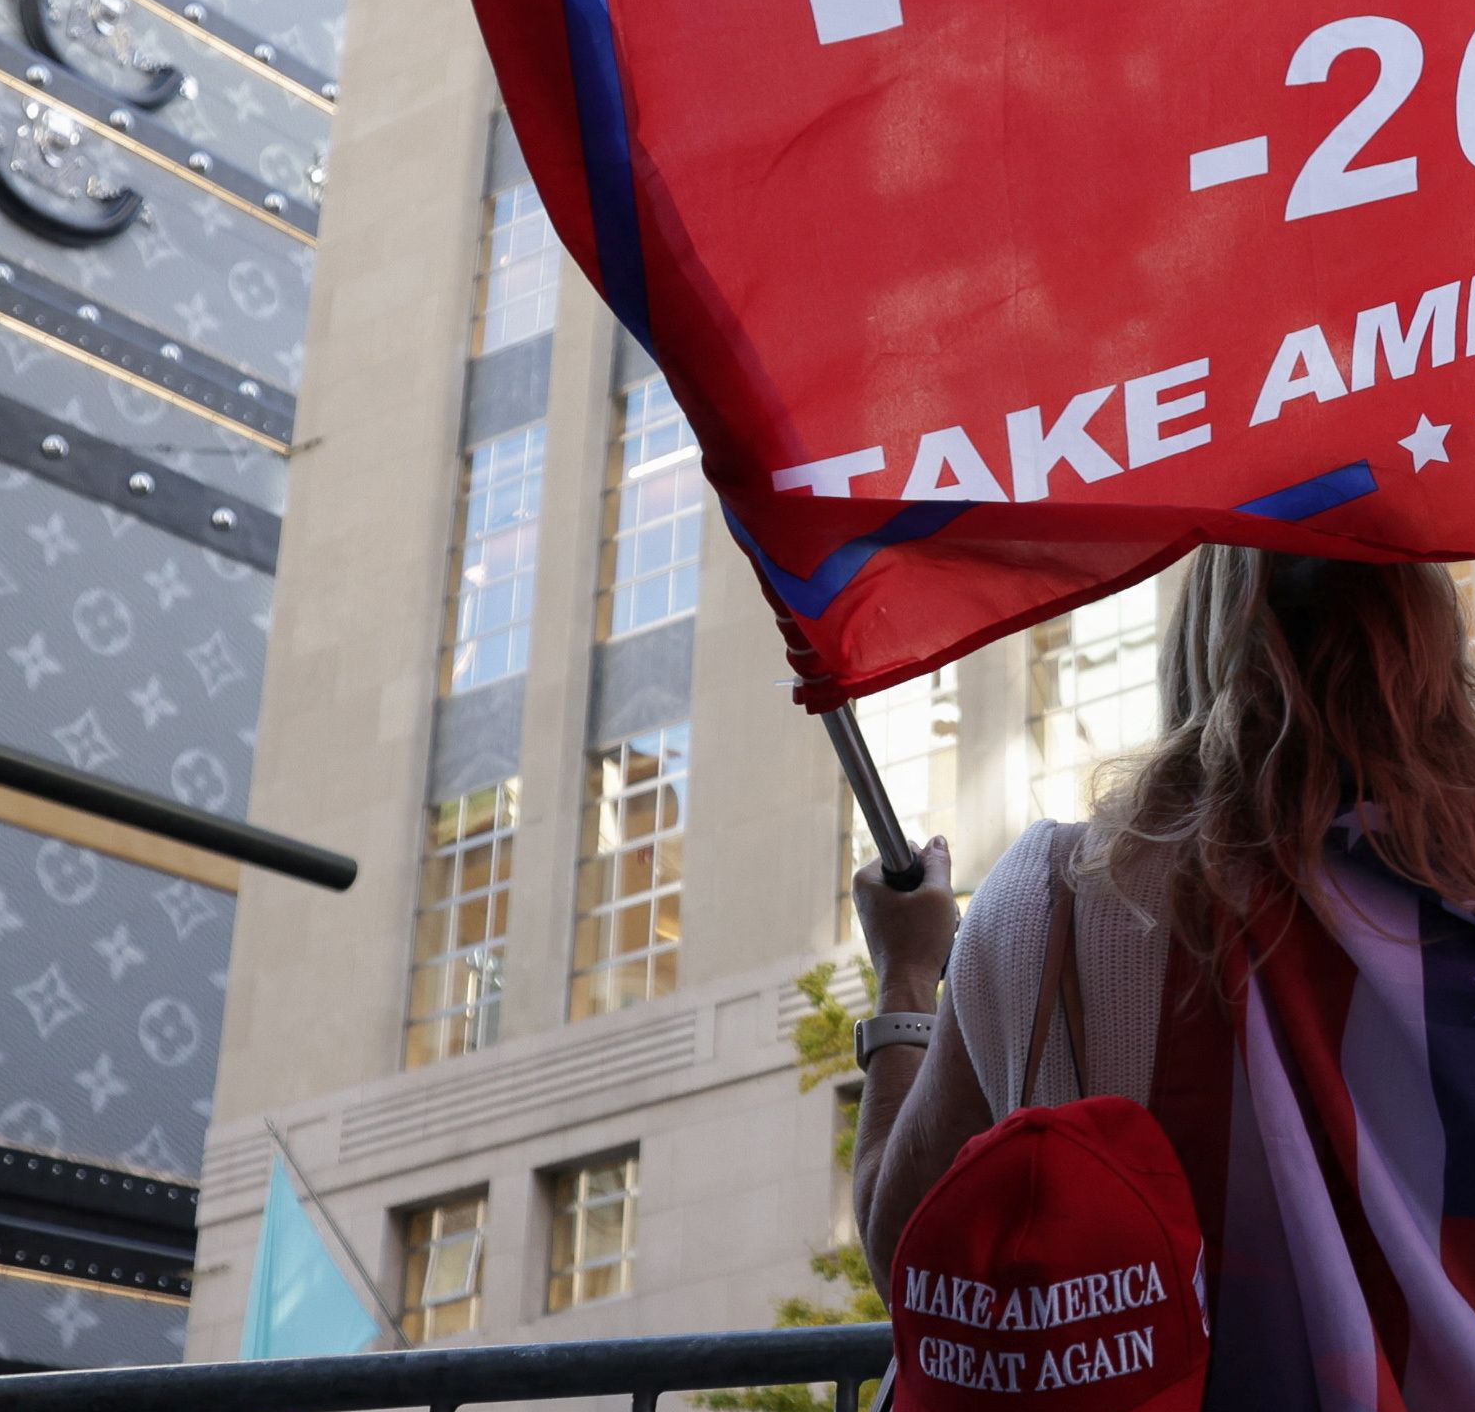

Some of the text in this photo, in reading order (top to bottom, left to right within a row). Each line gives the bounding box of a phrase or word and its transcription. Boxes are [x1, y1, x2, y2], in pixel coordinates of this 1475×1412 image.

[904, 1262, 1167, 1331] MAKE AMERICA
[919, 1327, 1155, 1392] GREAT AGAIN
